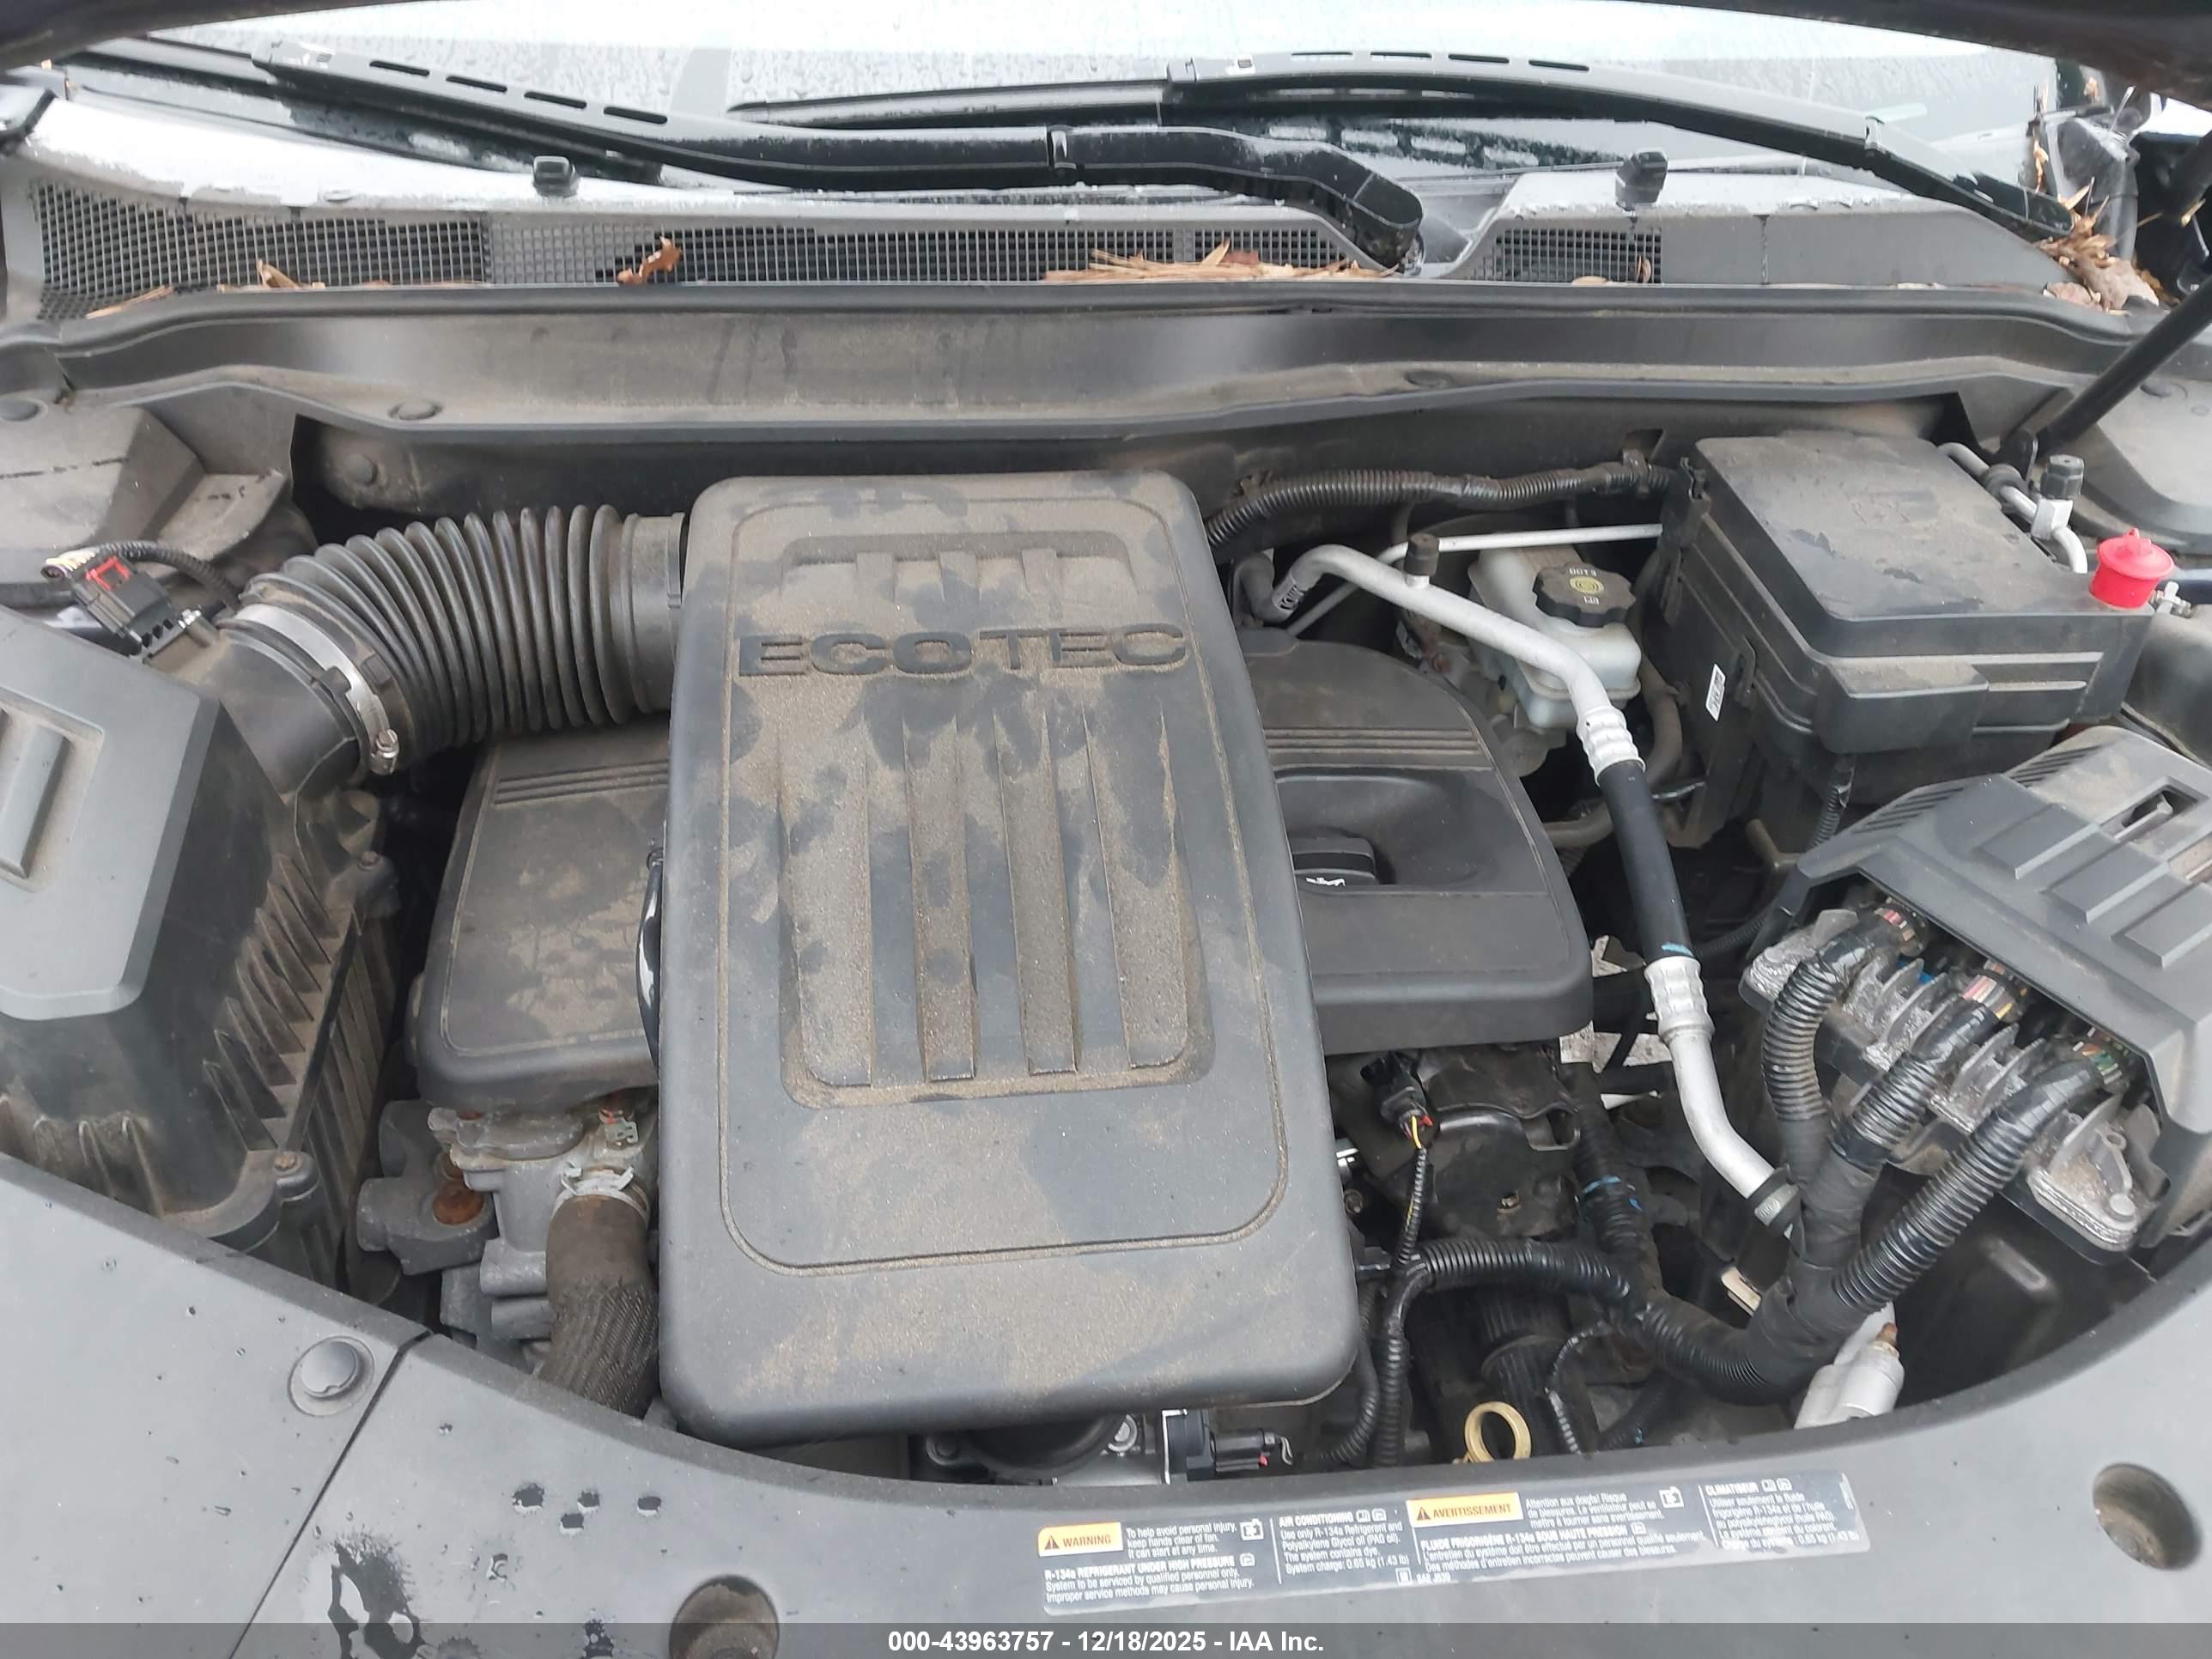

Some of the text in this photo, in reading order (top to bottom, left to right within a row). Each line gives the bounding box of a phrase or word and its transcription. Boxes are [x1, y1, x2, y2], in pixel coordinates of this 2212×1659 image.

[738, 623, 1187, 677] ECOTEC
[1279, 1512, 1353, 1526] AIR CONDITIONING
[1432, 1504, 1511, 1517] AVERTISSEMENT
[1127, 1522, 1237, 1539] To help avoid personal injury.
[1063, 1535, 1111, 1547] WARNING
[1044, 1556, 1235, 1580] R-134a REFRIGERANT UNDER HIGH PRESSURE
[1046, 1568, 1239, 1591] System to be serviced by qualified personnel only.
[1048, 1578, 1255, 1603] Improper service methods may cause personal injury.
